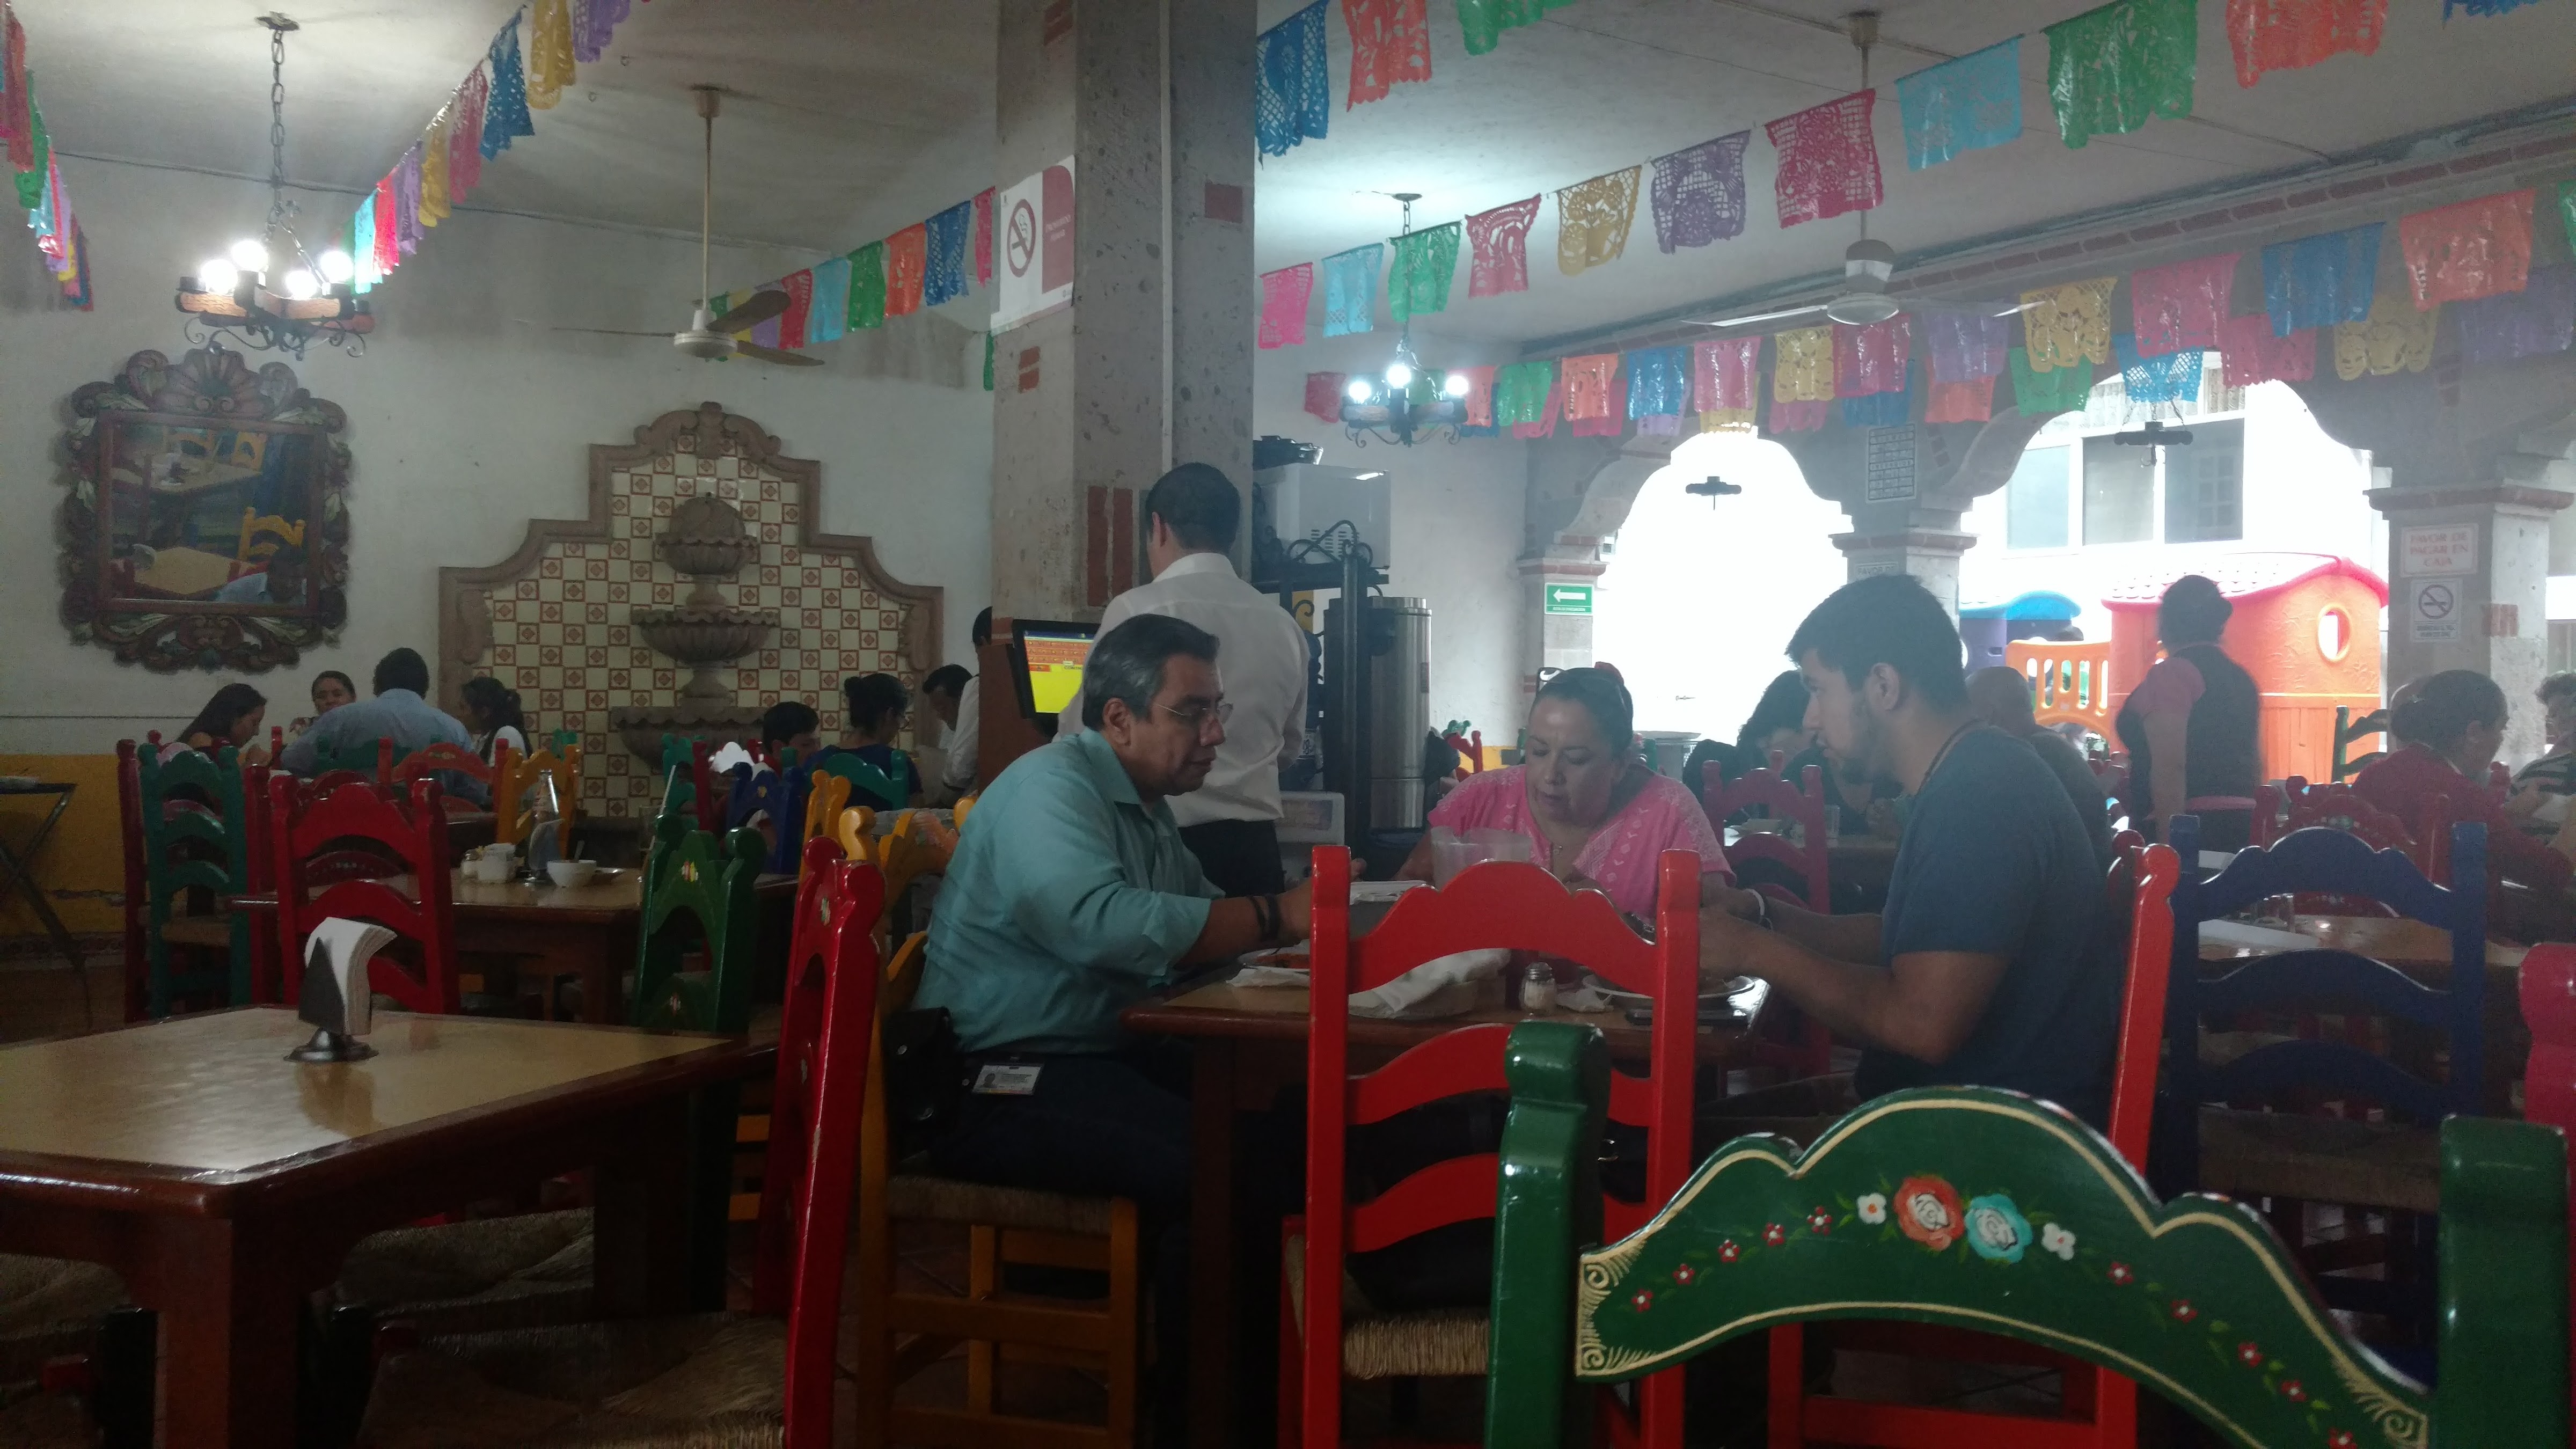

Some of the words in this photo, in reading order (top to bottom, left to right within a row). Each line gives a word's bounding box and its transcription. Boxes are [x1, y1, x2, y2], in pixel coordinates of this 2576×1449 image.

[2410, 533, 2447, 543] FAVOR
[2451, 532, 2467, 541] DE
[2410, 545, 2448, 554] PAGAR
[2452, 544, 2468, 554] EN
